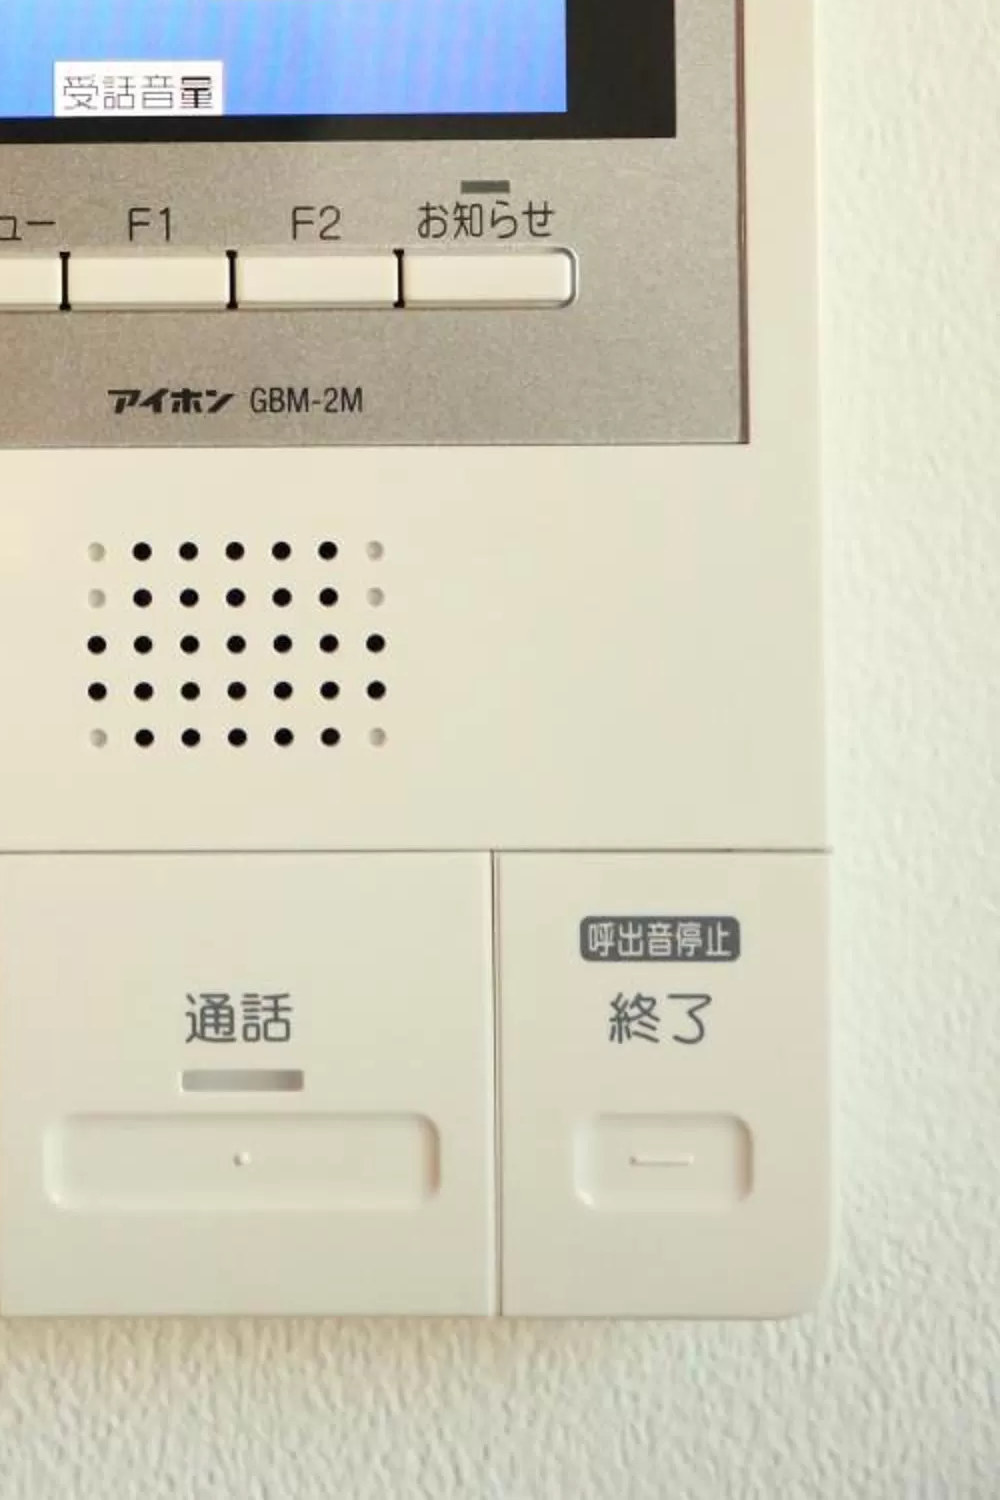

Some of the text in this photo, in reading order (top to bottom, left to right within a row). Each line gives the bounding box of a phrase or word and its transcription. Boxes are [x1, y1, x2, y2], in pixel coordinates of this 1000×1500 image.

[62, 73, 214, 111] 受話音量
[127, 206, 173, 242] F1
[291, 204, 342, 242] F2
[416, 199, 556, 240] お知らせ
[107, 386, 363, 415] アイホン GBM-2M
[588, 921, 731, 957] 呼出音停止
[185, 992, 293, 1044] 通話
[608, 991, 714, 1045] 終了
